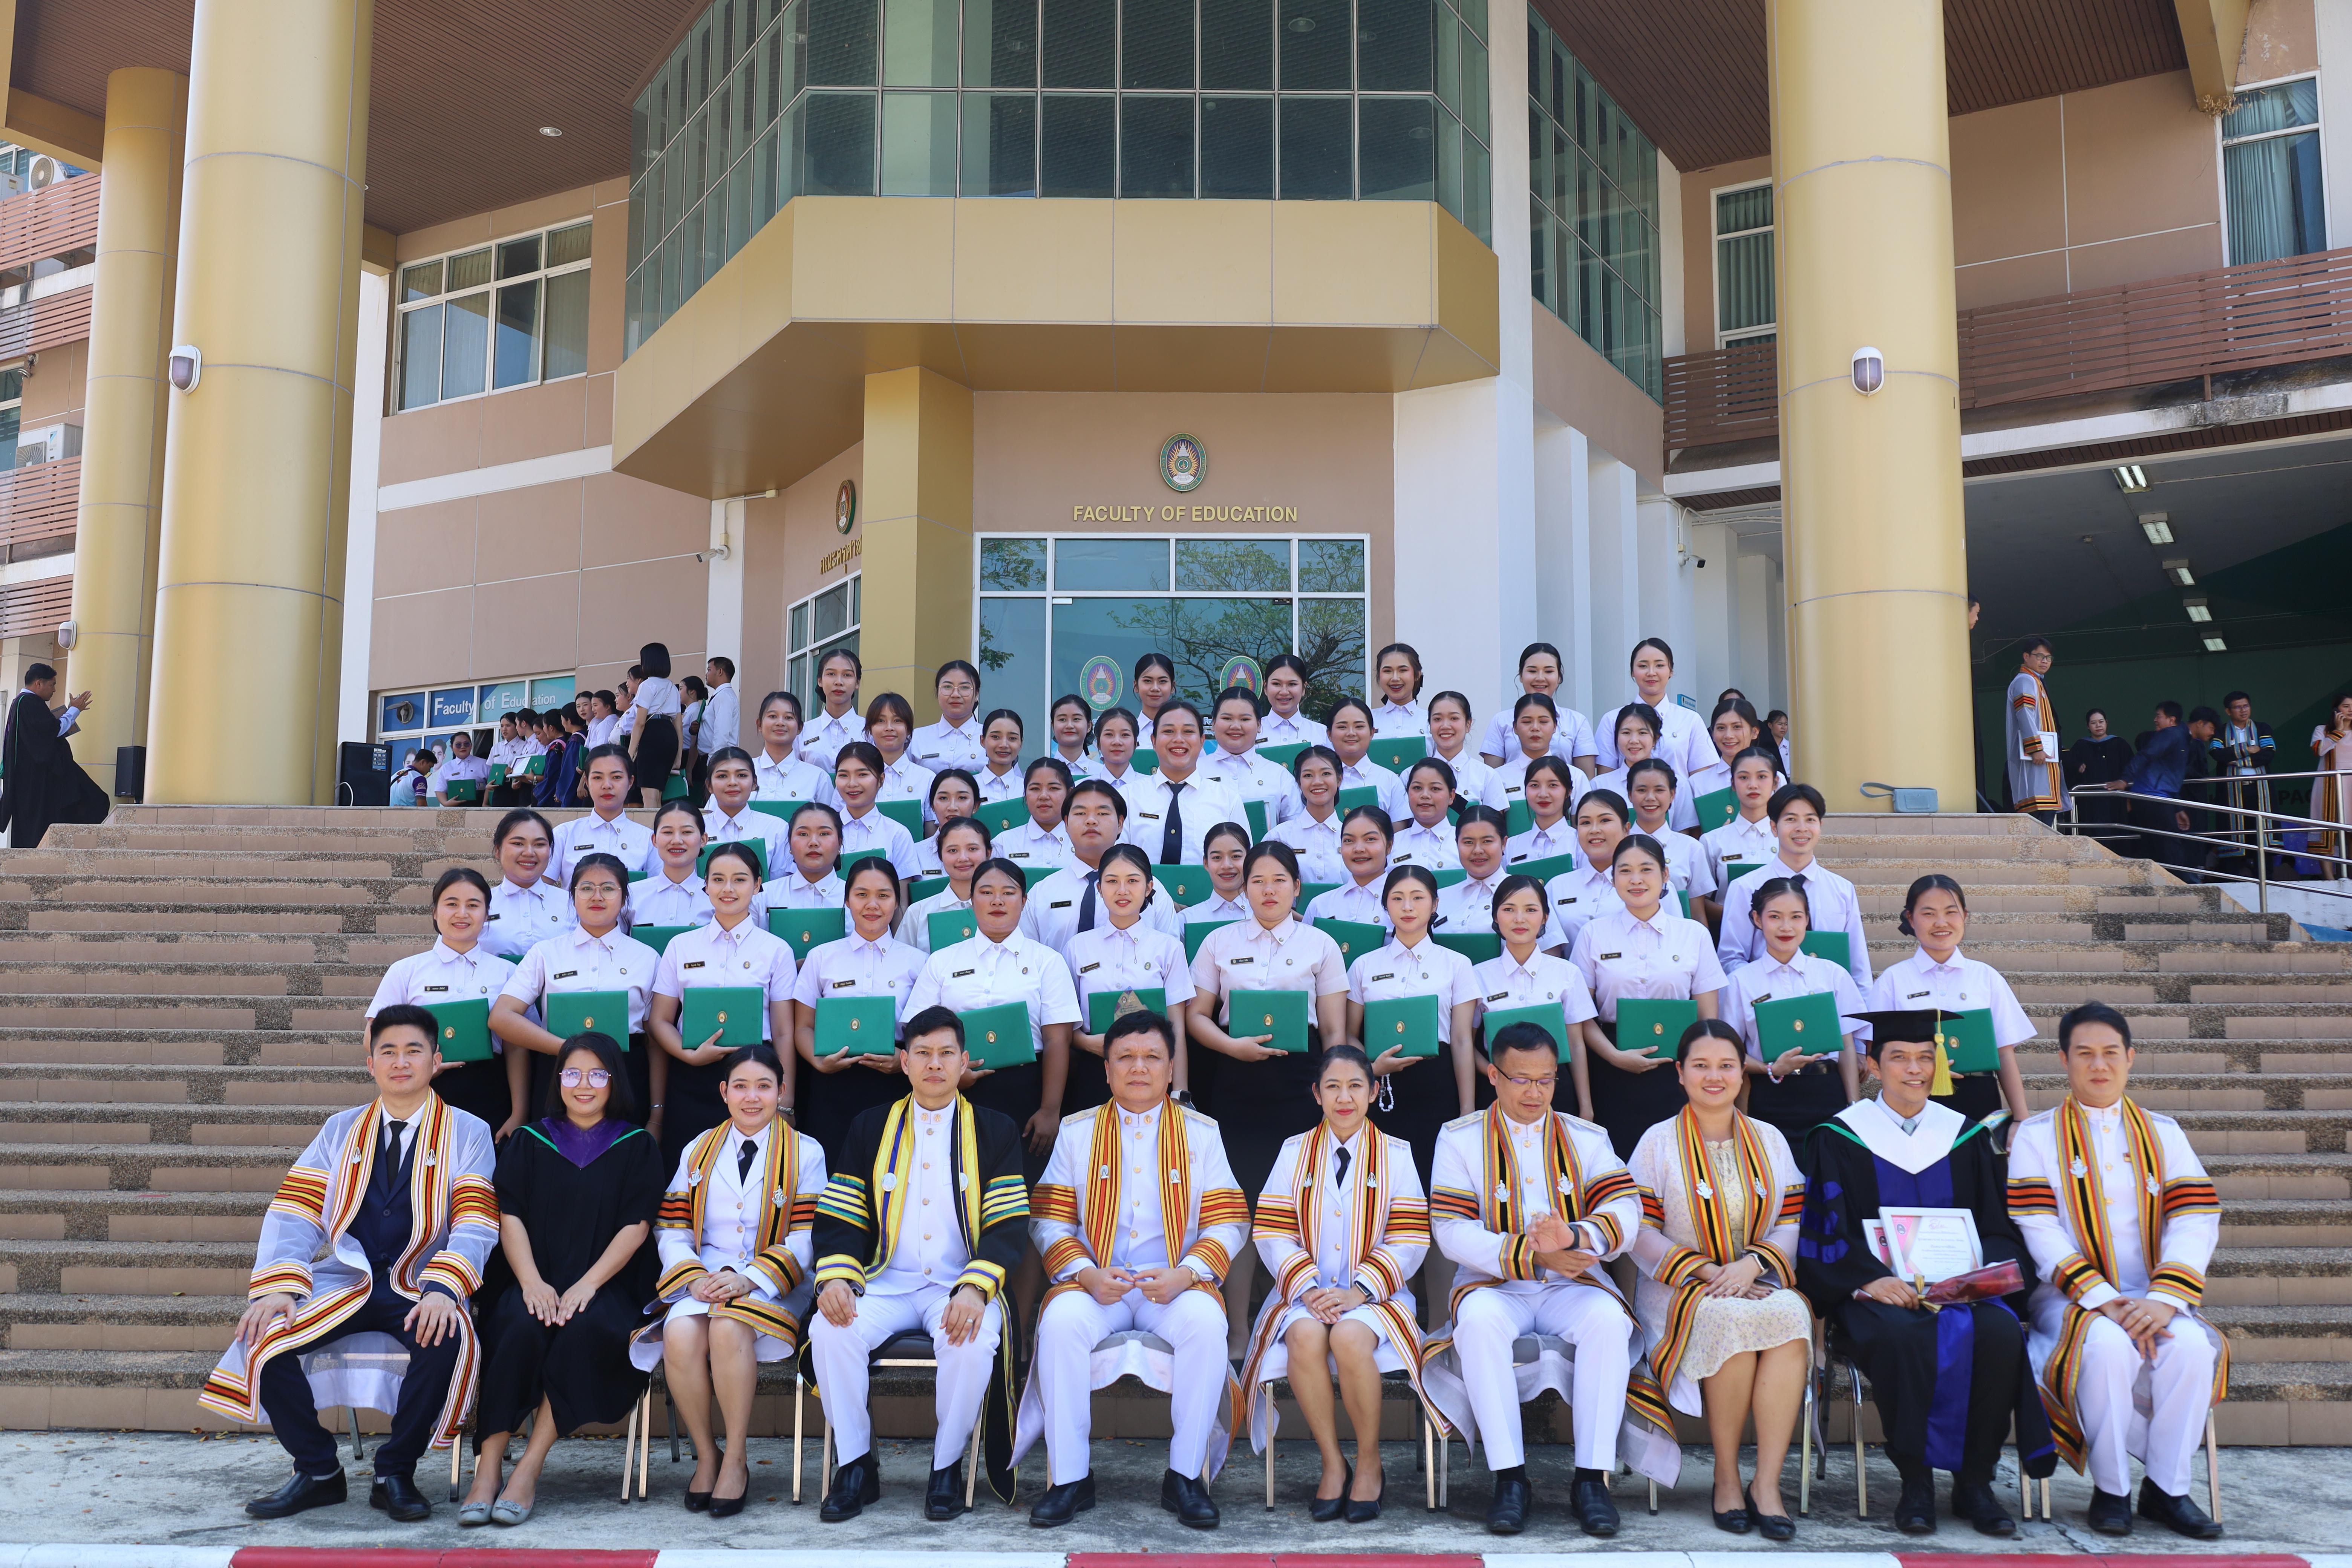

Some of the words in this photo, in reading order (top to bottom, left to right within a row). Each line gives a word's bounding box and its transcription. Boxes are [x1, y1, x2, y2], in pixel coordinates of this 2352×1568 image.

[1073, 506, 1155, 521] FACULTY
[1161, 506, 1186, 521] OF
[1192, 506, 1298, 522] EDUCATION
[820, 534, 862, 574] คณะครุศาส
[434, 697, 475, 716] Faculty
[484, 695, 496, 710] of
[501, 692, 556, 709] Education
